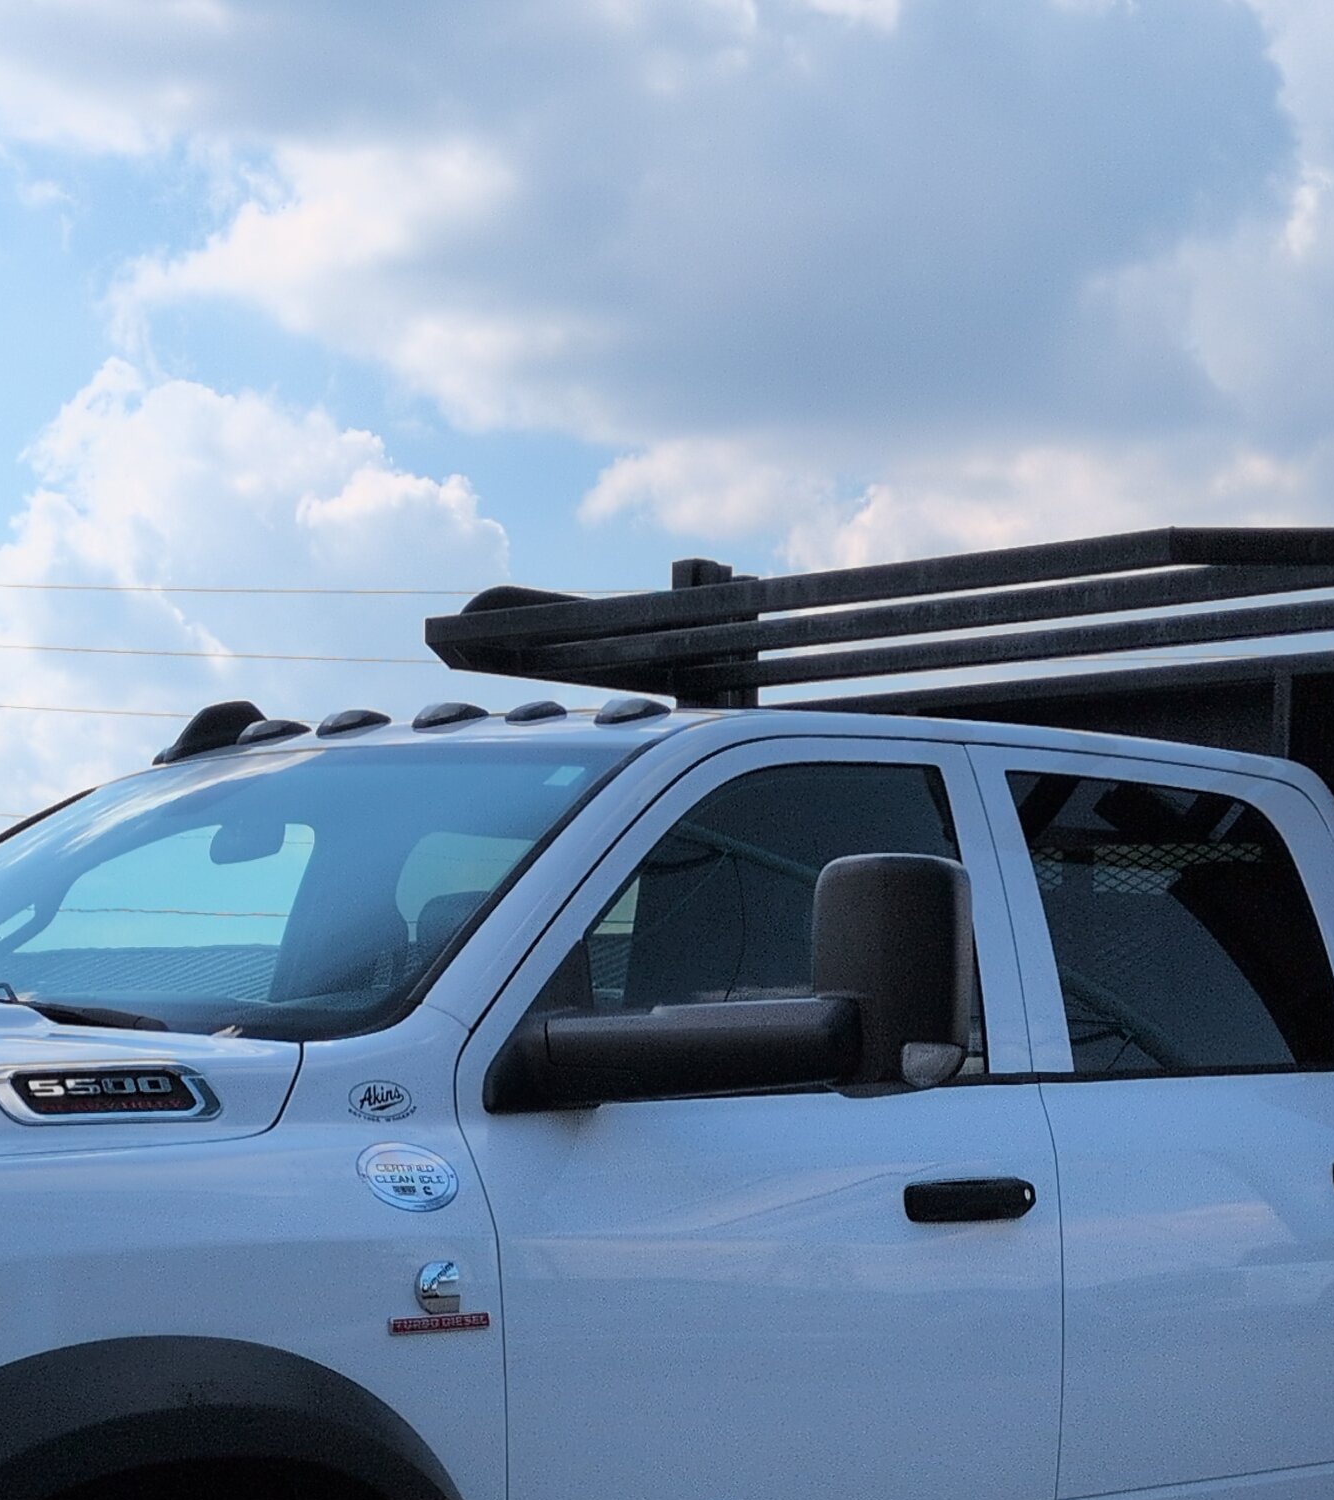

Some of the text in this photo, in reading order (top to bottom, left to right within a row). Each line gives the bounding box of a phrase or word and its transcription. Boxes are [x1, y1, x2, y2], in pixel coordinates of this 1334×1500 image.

[28, 1077, 172, 1097] 5500
[359, 1085, 405, 1110] Akins
[374, 1175, 446, 1185] CLEAN IDLE
[394, 1315, 488, 1331] TURBO DIESEL
